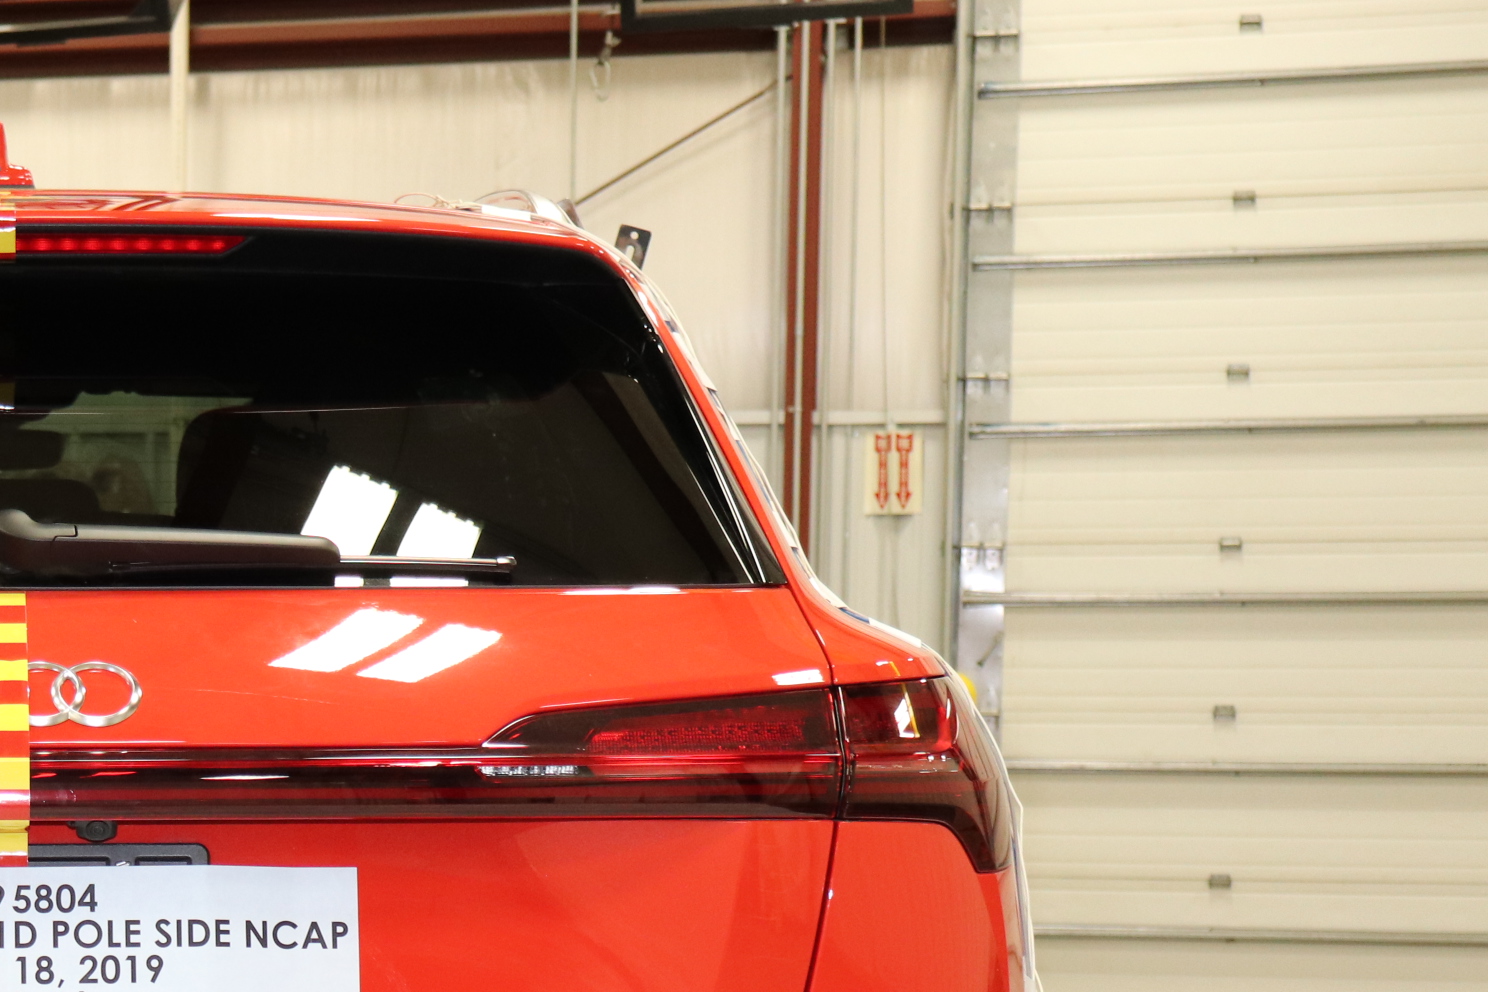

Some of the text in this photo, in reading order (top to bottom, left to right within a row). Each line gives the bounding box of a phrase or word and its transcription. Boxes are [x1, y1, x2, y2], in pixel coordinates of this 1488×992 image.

[52, 920, 141, 949] POLE
[154, 918, 230, 948] SIDE
[245, 919, 349, 950] NCAP
[16, 955, 64, 988] 18,
[78, 954, 164, 984] 2019
